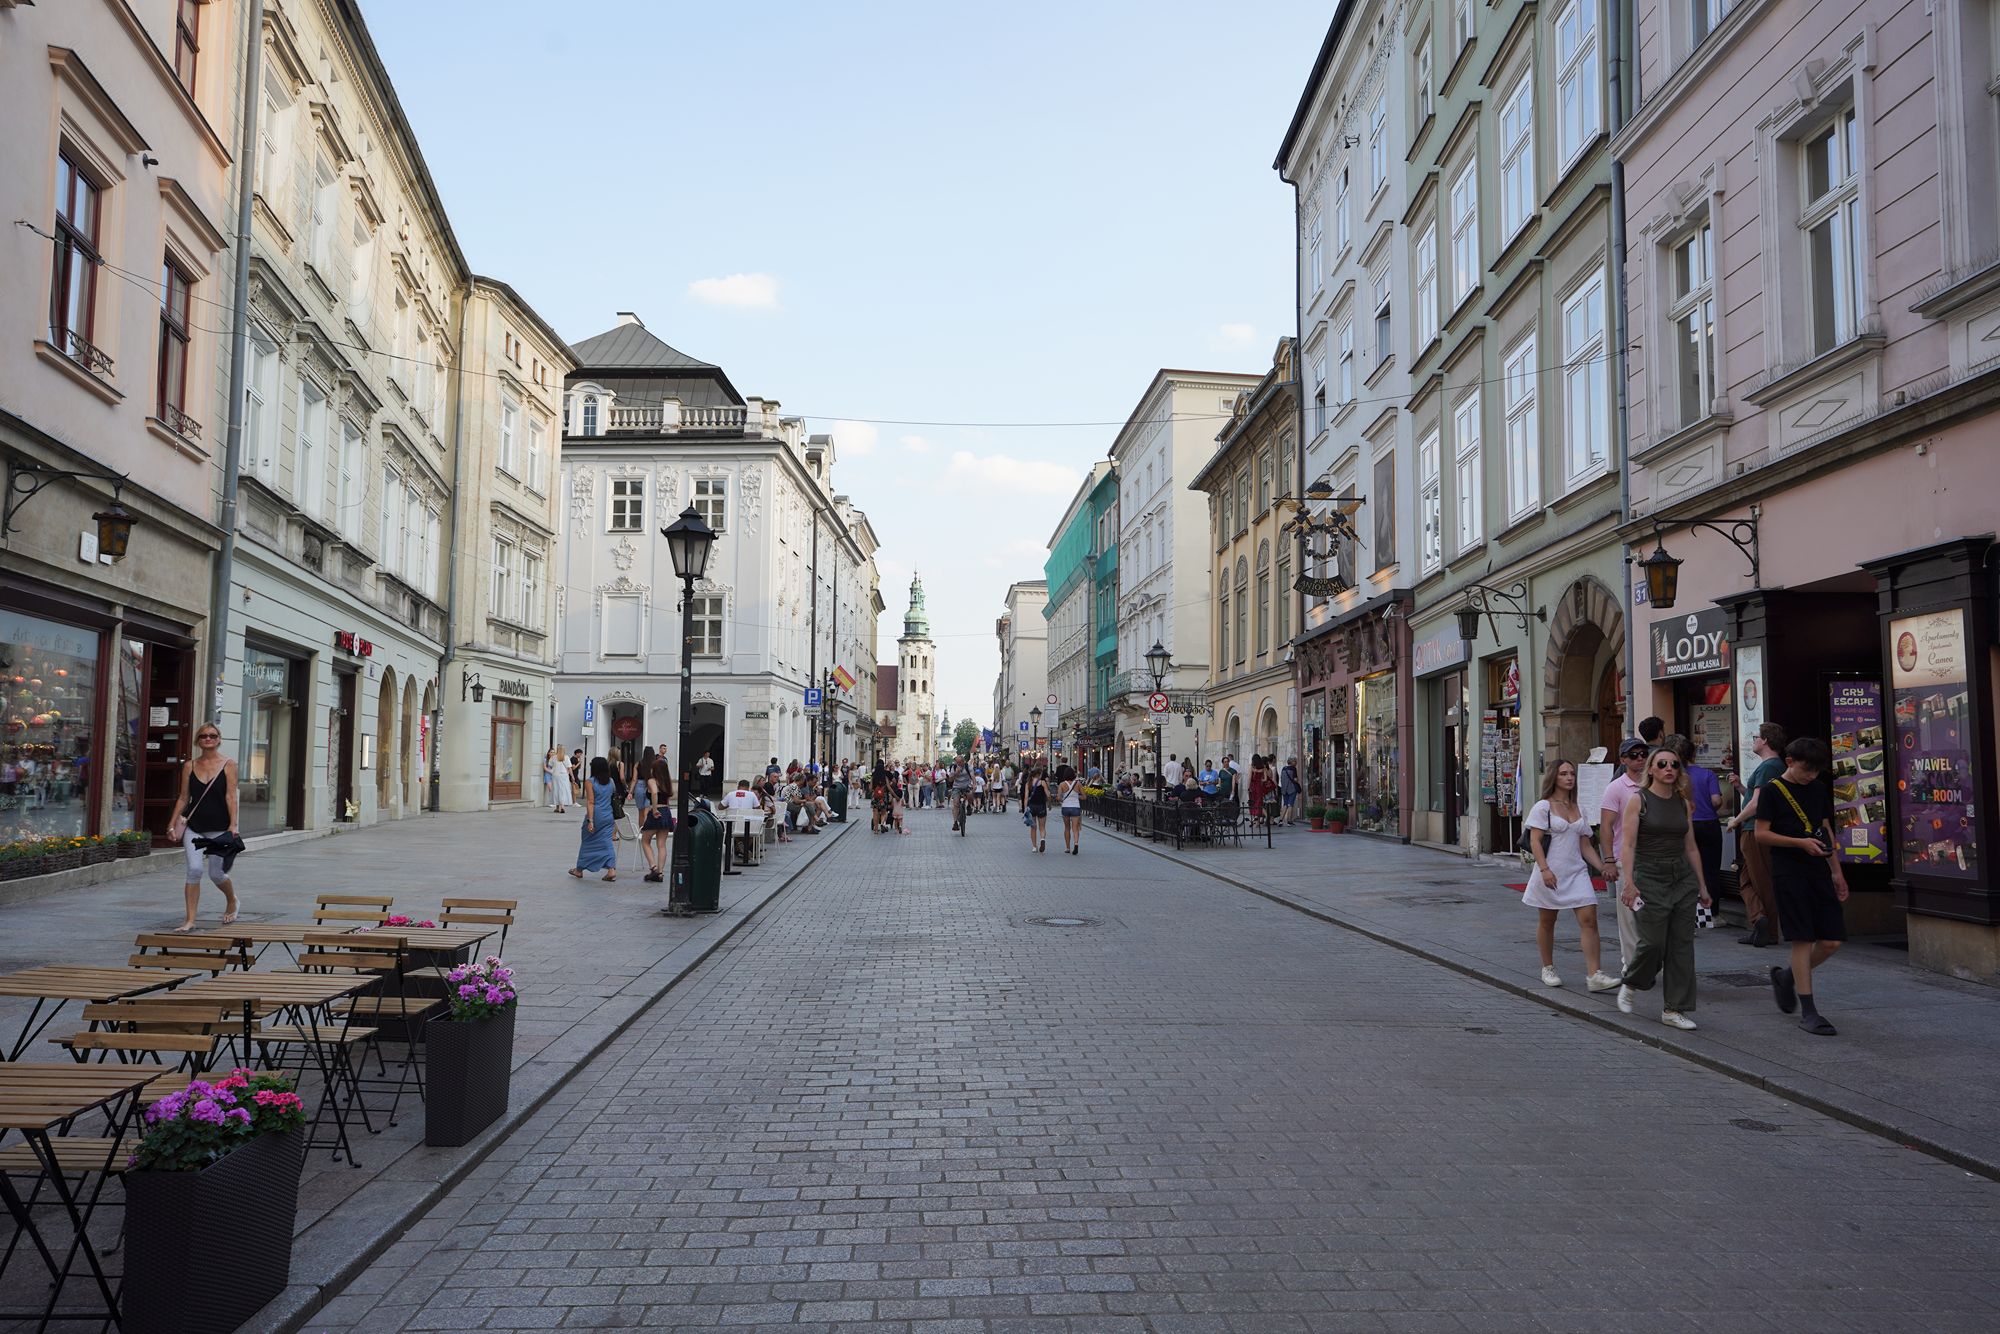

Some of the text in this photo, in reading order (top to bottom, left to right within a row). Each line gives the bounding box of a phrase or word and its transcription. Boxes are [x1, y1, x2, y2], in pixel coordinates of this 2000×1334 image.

[1636, 588, 1646, 602] 31
[1664, 630, 1723, 663] LODY
[242, 661, 257, 677] ORLD
[258, 665, 265, 680] OF
[1667, 659, 1720, 674] PRODUKCJA WŁASNA
[500, 680, 529, 697] PANDORA
[1842, 688, 1864, 696] GRY
[1833, 698, 1874, 706] ESCAPE
[1914, 758, 1952, 771] WAWEL
[1933, 789, 1962, 802] ROOM
